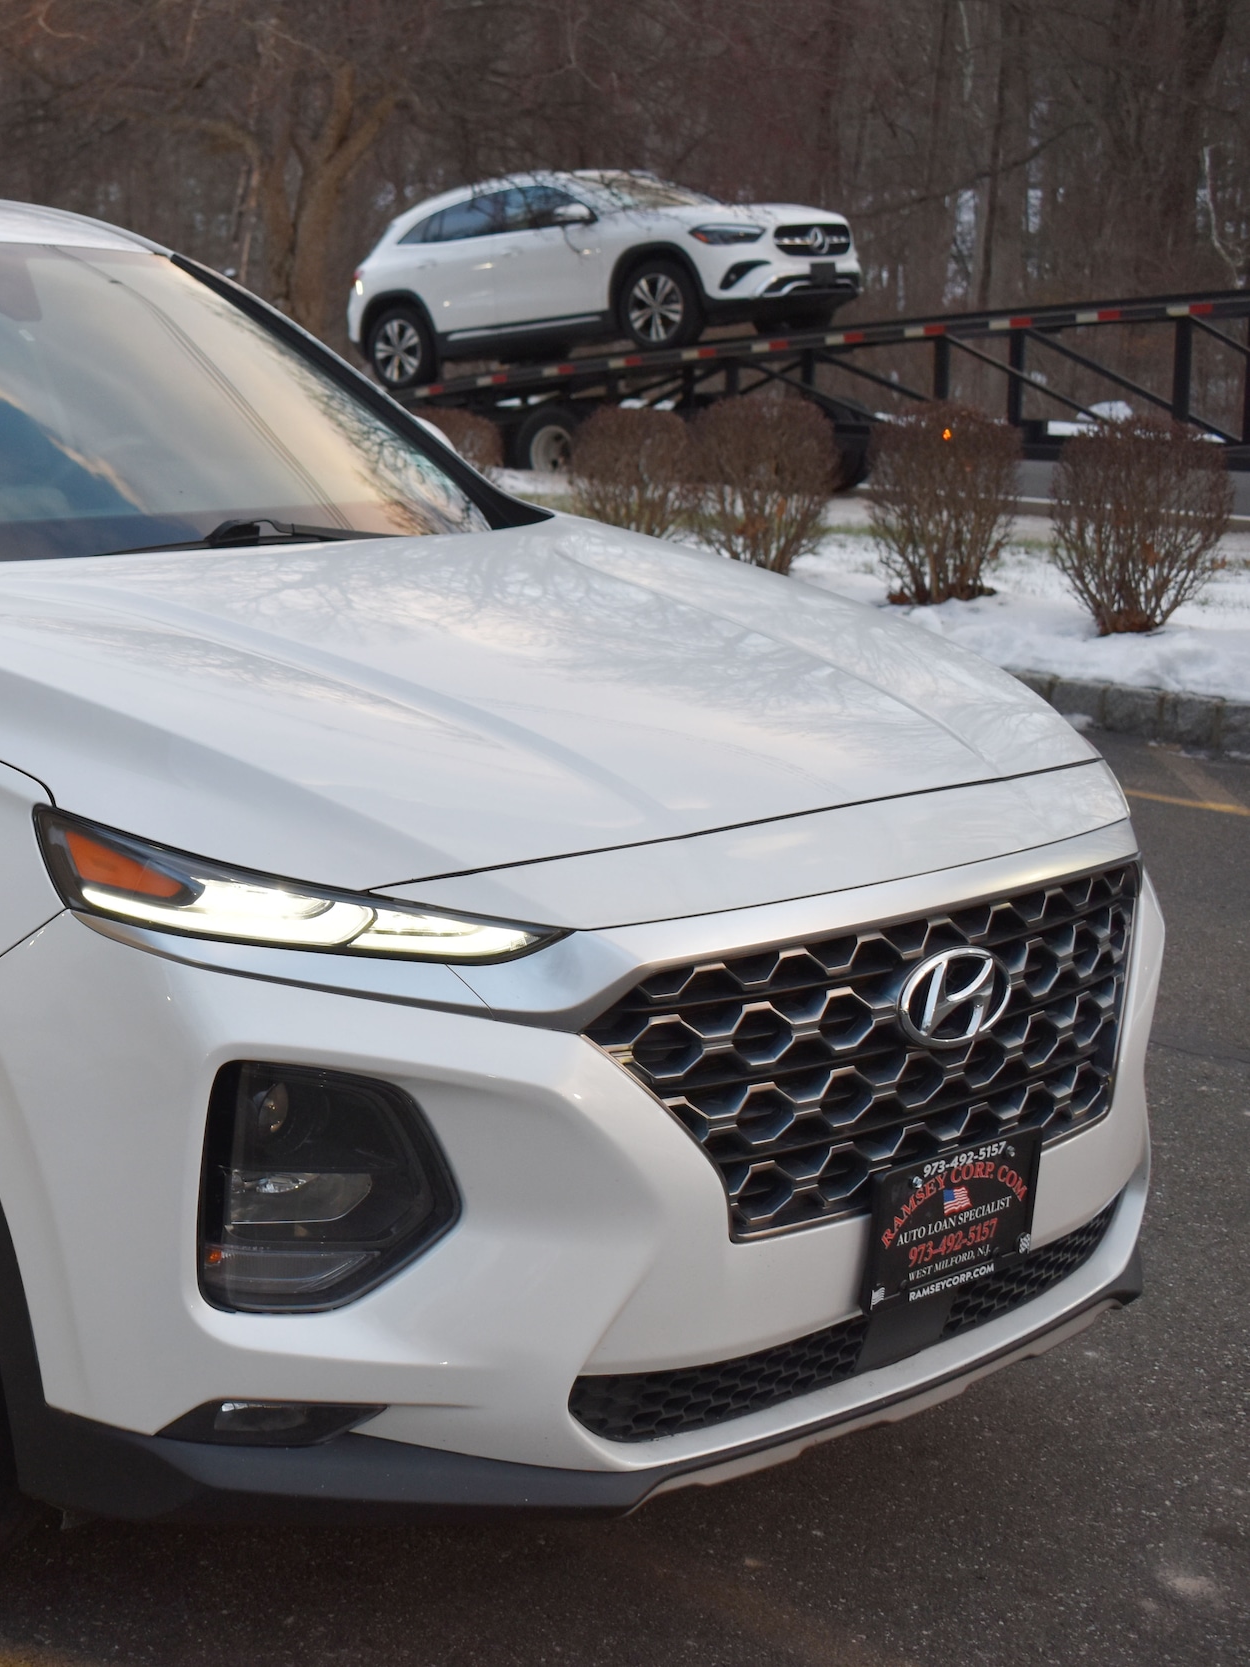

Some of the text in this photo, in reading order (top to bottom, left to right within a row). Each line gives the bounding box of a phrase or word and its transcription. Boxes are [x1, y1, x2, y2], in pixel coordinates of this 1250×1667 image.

[923, 1141, 1007, 1178] 973-492-5157
[880, 1171, 947, 1249] RAMSEY
[996, 1164, 1029, 1202] COM
[897, 1195, 1013, 1246] AUTO LOAN SPECIALIST
[908, 1217, 998, 1268] 973-492-5157
[908, 1265, 933, 1281] WEST
[933, 1250, 976, 1273] MILFORD,
[908, 1262, 995, 1302] RAMSEYCORP.COM
